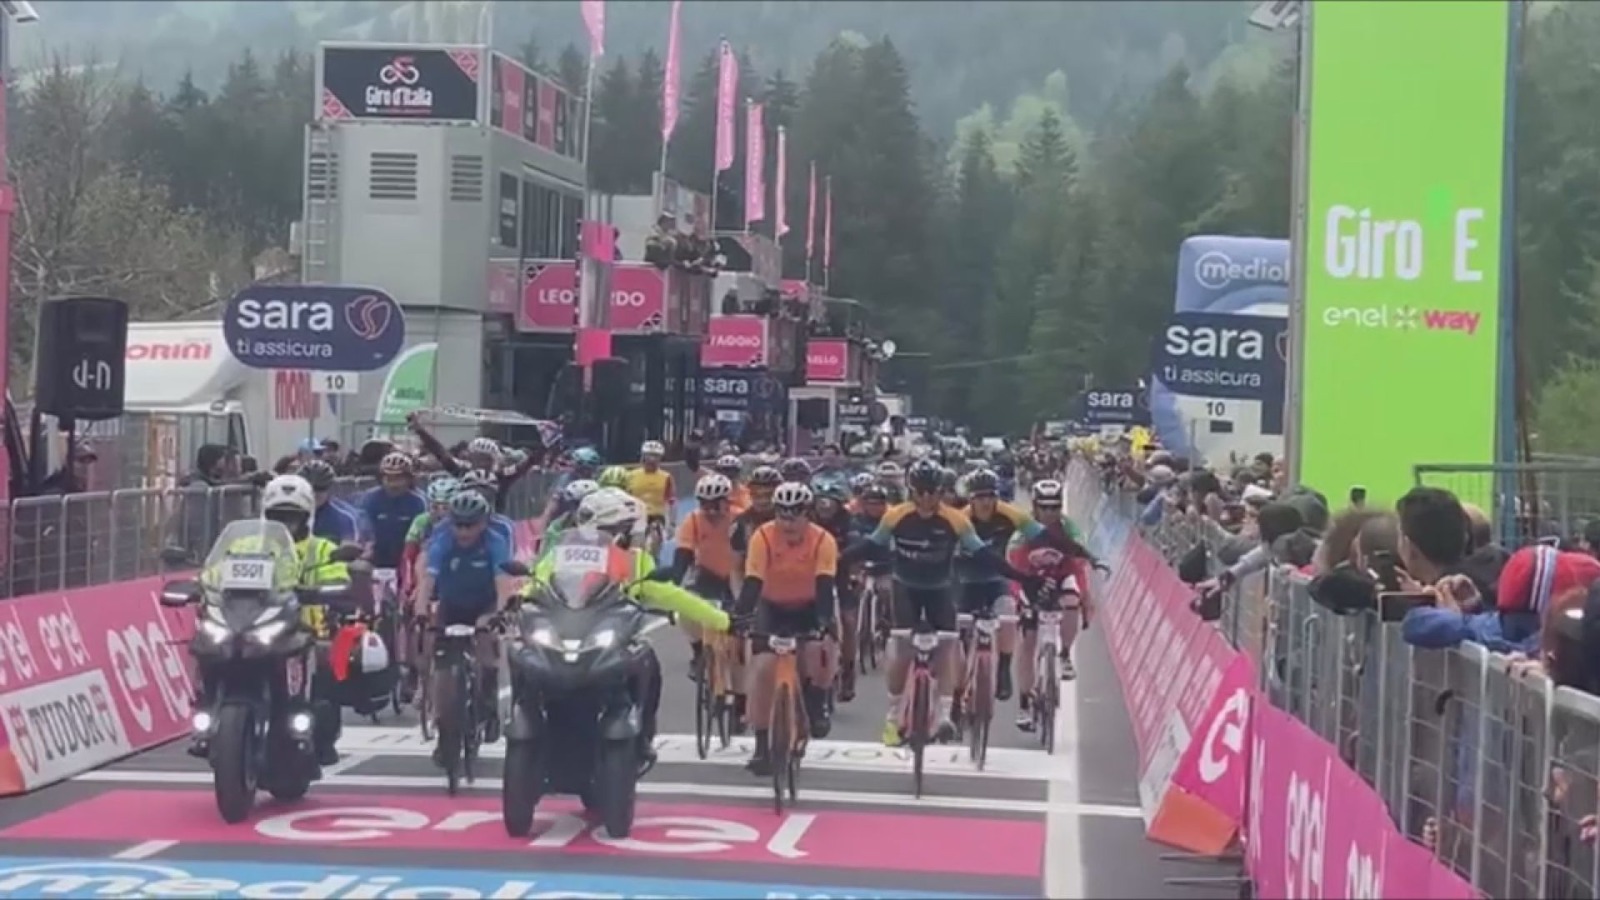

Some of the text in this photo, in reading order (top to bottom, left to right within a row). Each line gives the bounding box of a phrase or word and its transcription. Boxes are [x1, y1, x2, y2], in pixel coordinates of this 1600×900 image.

[366, 86, 390, 106] Giro
[1326, 205, 1423, 279] Giro
[539, 289, 645, 306] LEODO
[237, 298, 333, 331] sara
[1323, 305, 1388, 327] enel
[1424, 310, 1481, 334] way
[236, 338, 332, 358] ti assicura
[1165, 325, 1263, 360] sara
[325, 376, 345, 389] 10
[704, 378, 748, 394] sara
[1164, 365, 1261, 387] ti assicura
[1088, 391, 1133, 407] sara
[1206, 402, 1225, 416] 10
[38, 597, 91, 671] enel
[27, 693, 104, 760] TUDOR
